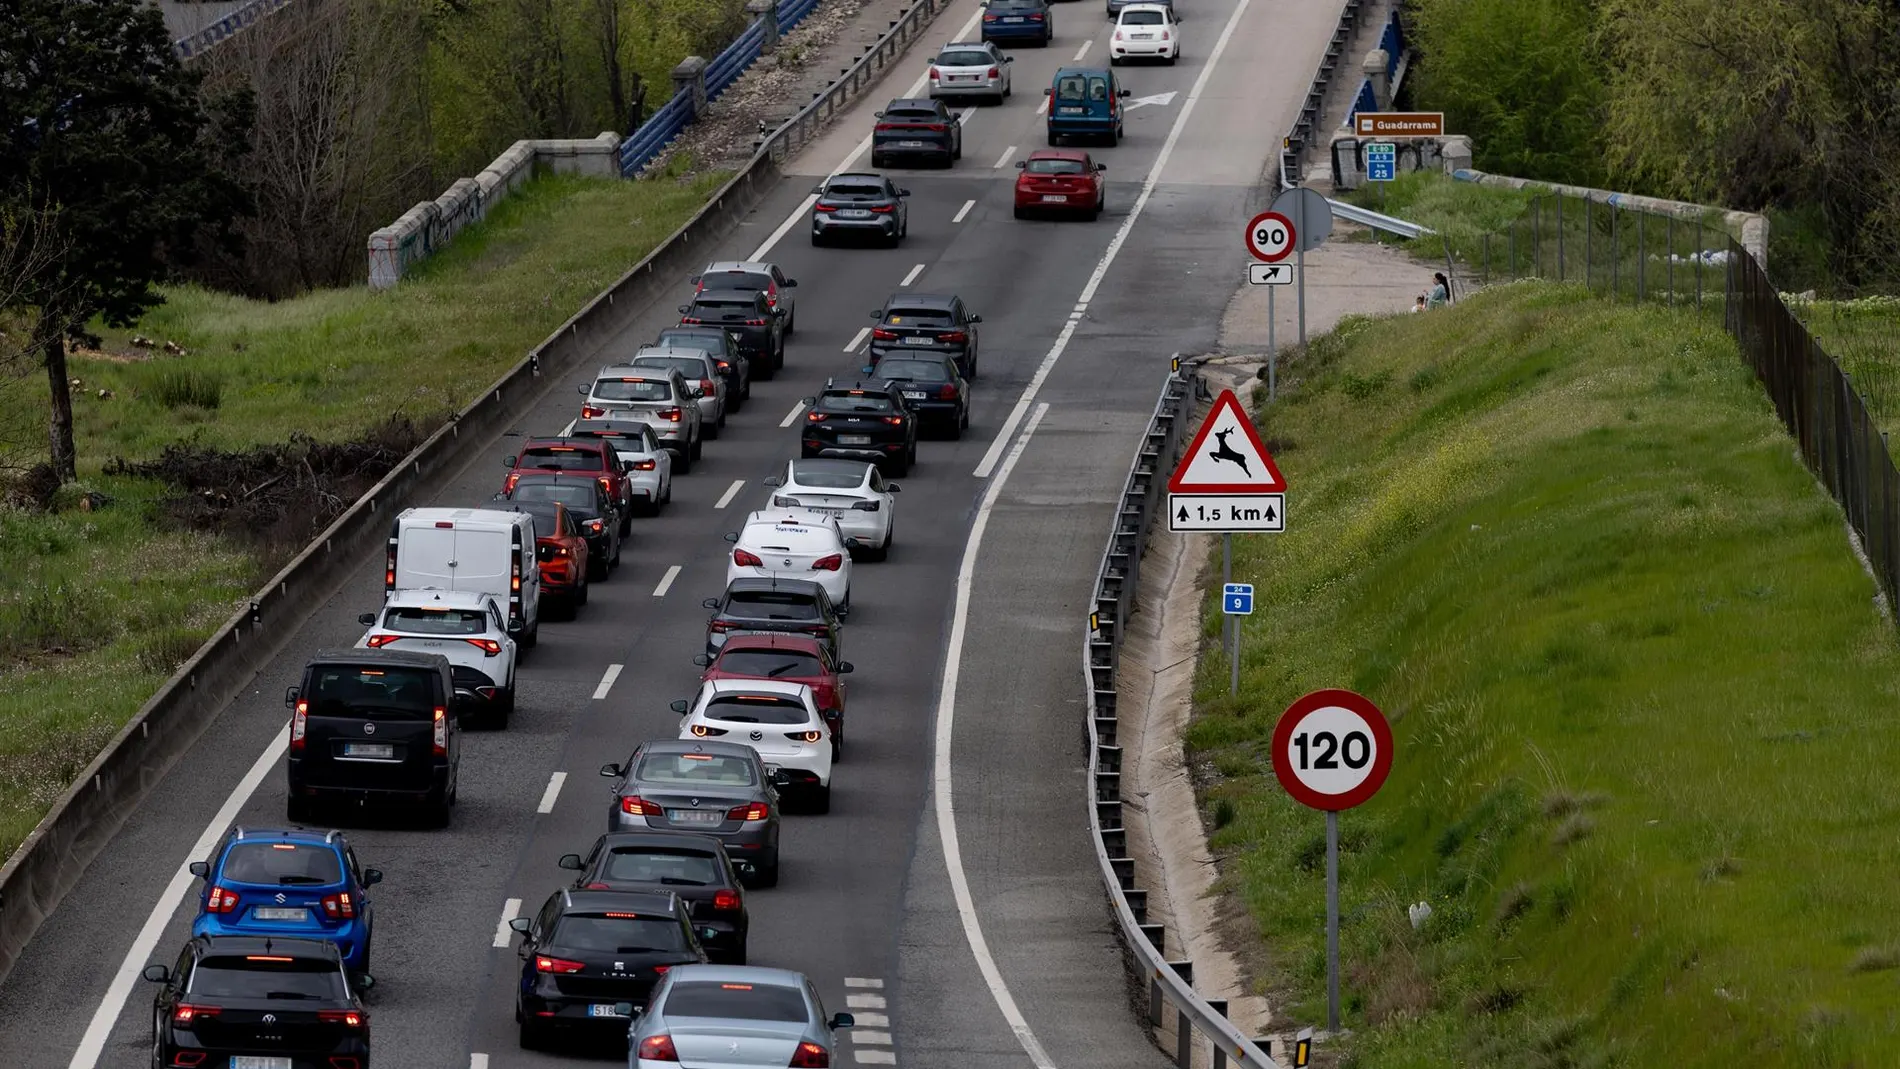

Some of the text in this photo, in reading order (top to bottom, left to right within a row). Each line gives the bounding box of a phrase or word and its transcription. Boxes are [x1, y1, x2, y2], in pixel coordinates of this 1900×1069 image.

[1377, 121, 1437, 129] Guadarrama
[1374, 170, 1388, 178] 25
[1257, 229, 1284, 245] 90
[1197, 505, 1260, 522] 1,5 km
[1234, 598, 1242, 609] 9
[1294, 731, 1370, 769] 120
